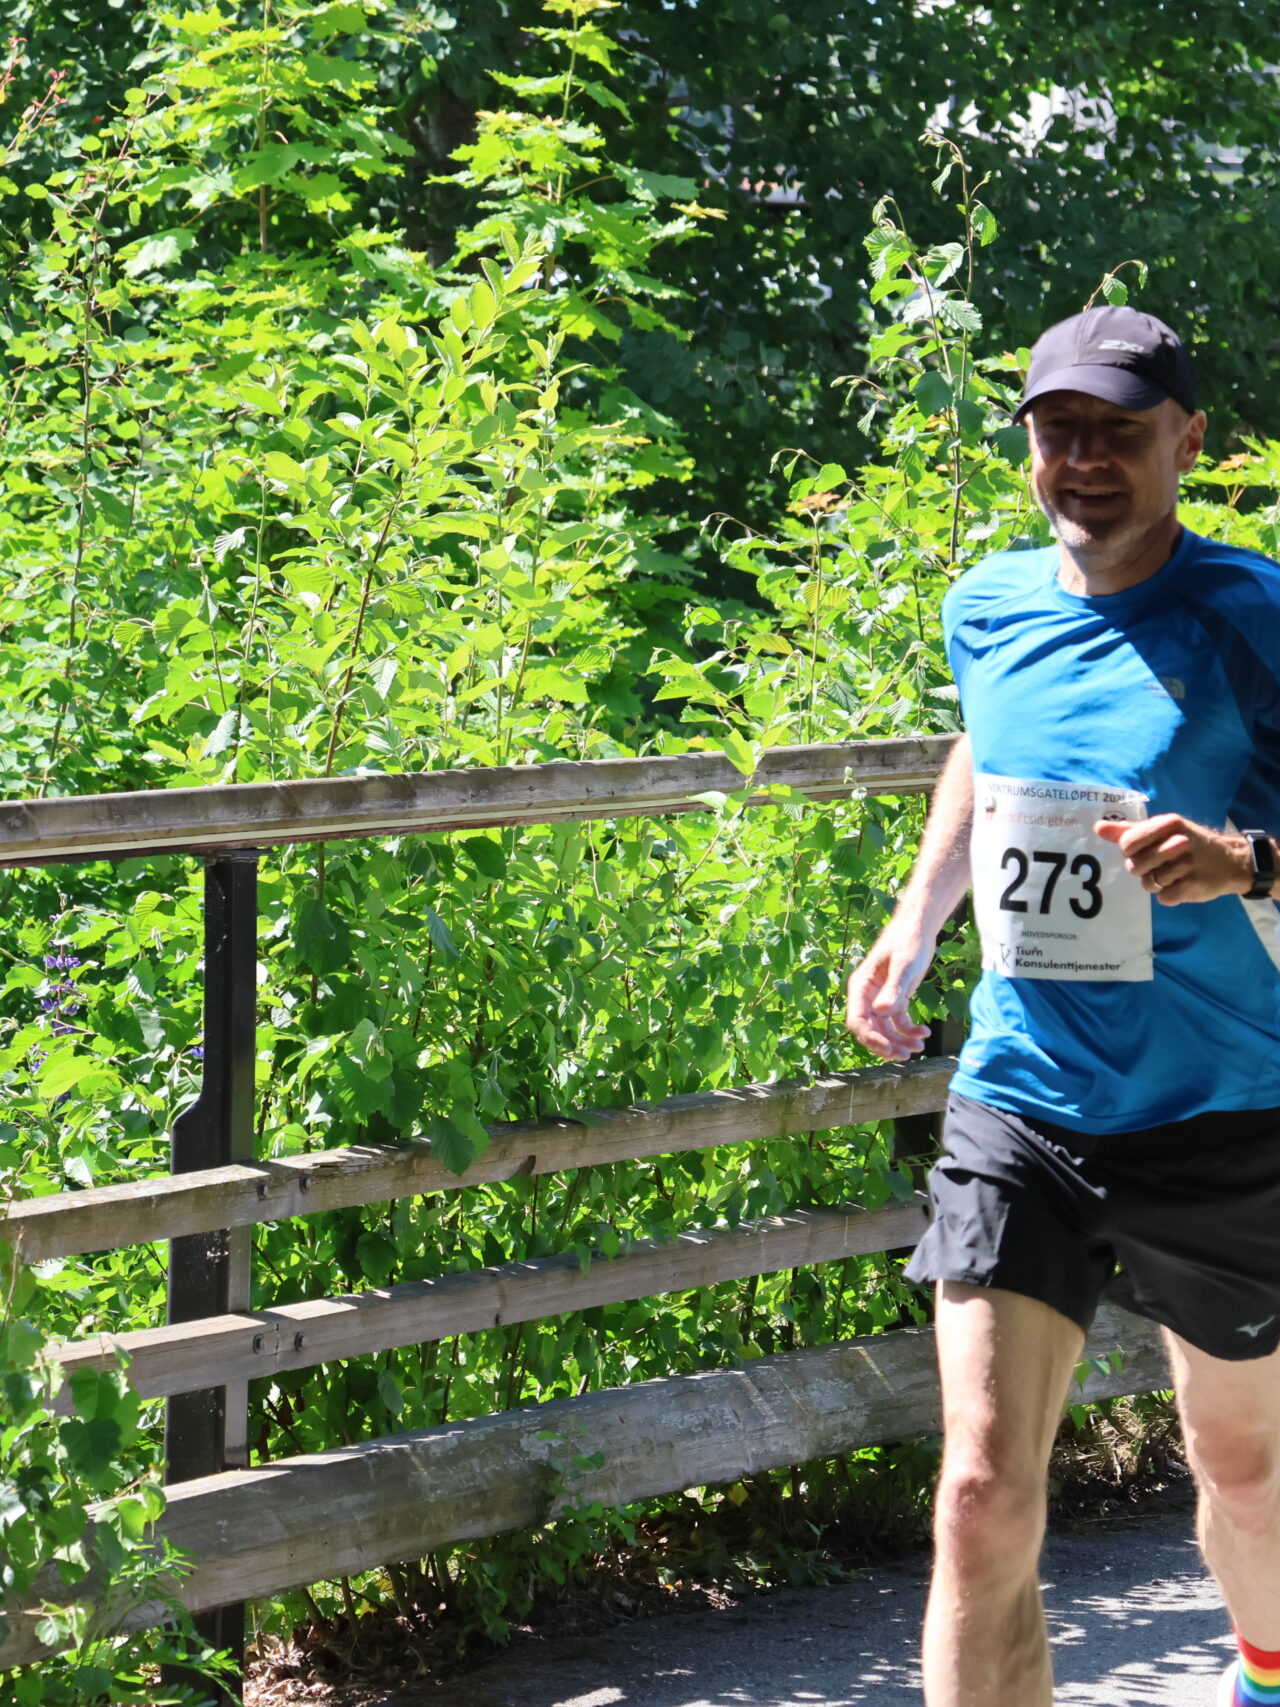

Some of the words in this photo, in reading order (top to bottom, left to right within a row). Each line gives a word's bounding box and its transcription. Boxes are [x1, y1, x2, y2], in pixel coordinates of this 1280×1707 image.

[999, 847, 1104, 920] 273
[1021, 930, 1078, 941] HOVEDSPONSOR
[1015, 957, 1121, 973] Konsulenttjenester
